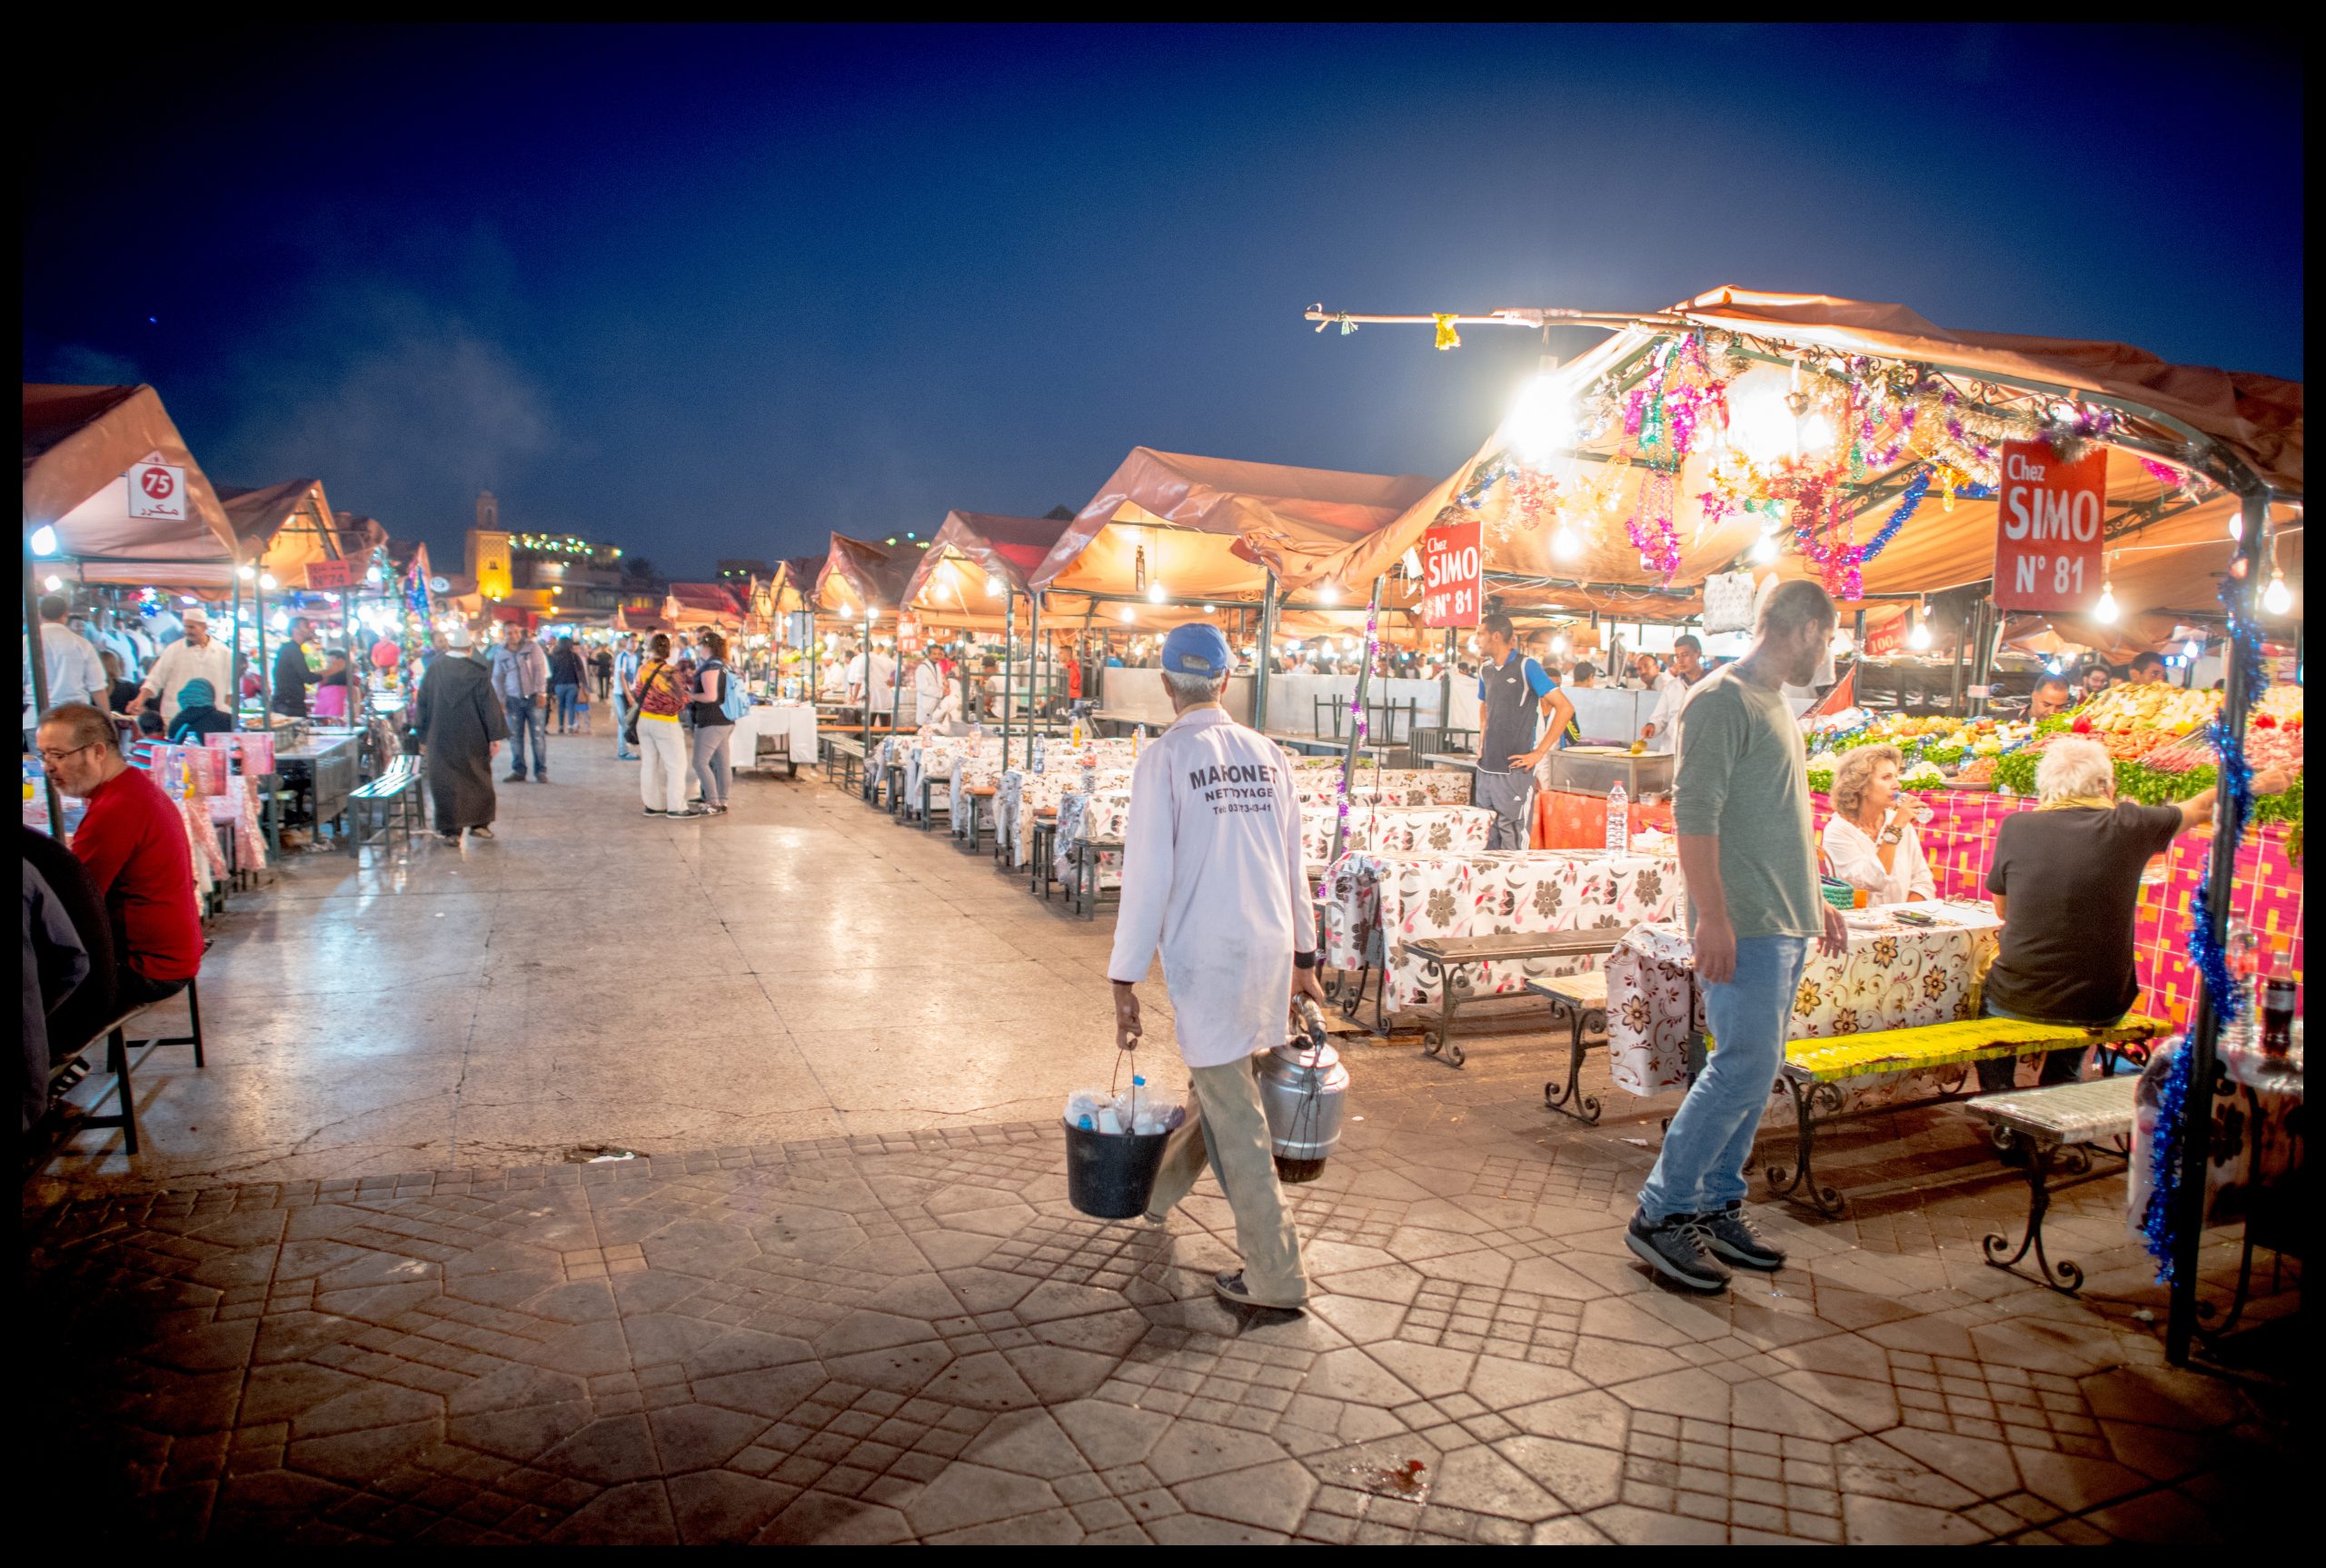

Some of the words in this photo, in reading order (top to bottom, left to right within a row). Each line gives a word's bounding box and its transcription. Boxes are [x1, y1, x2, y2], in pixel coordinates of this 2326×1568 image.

[2007, 453, 2045, 481] Chez
[145, 473, 170, 493] 75
[2004, 486, 2100, 542] SIMO
[1427, 537, 1447, 553] Chez
[1427, 546, 1478, 588] SIMO
[2015, 555, 2046, 593] N°
[2053, 555, 2084, 594] 81
[1435, 592, 1451, 618] N°
[1455, 588, 1473, 614] 81
